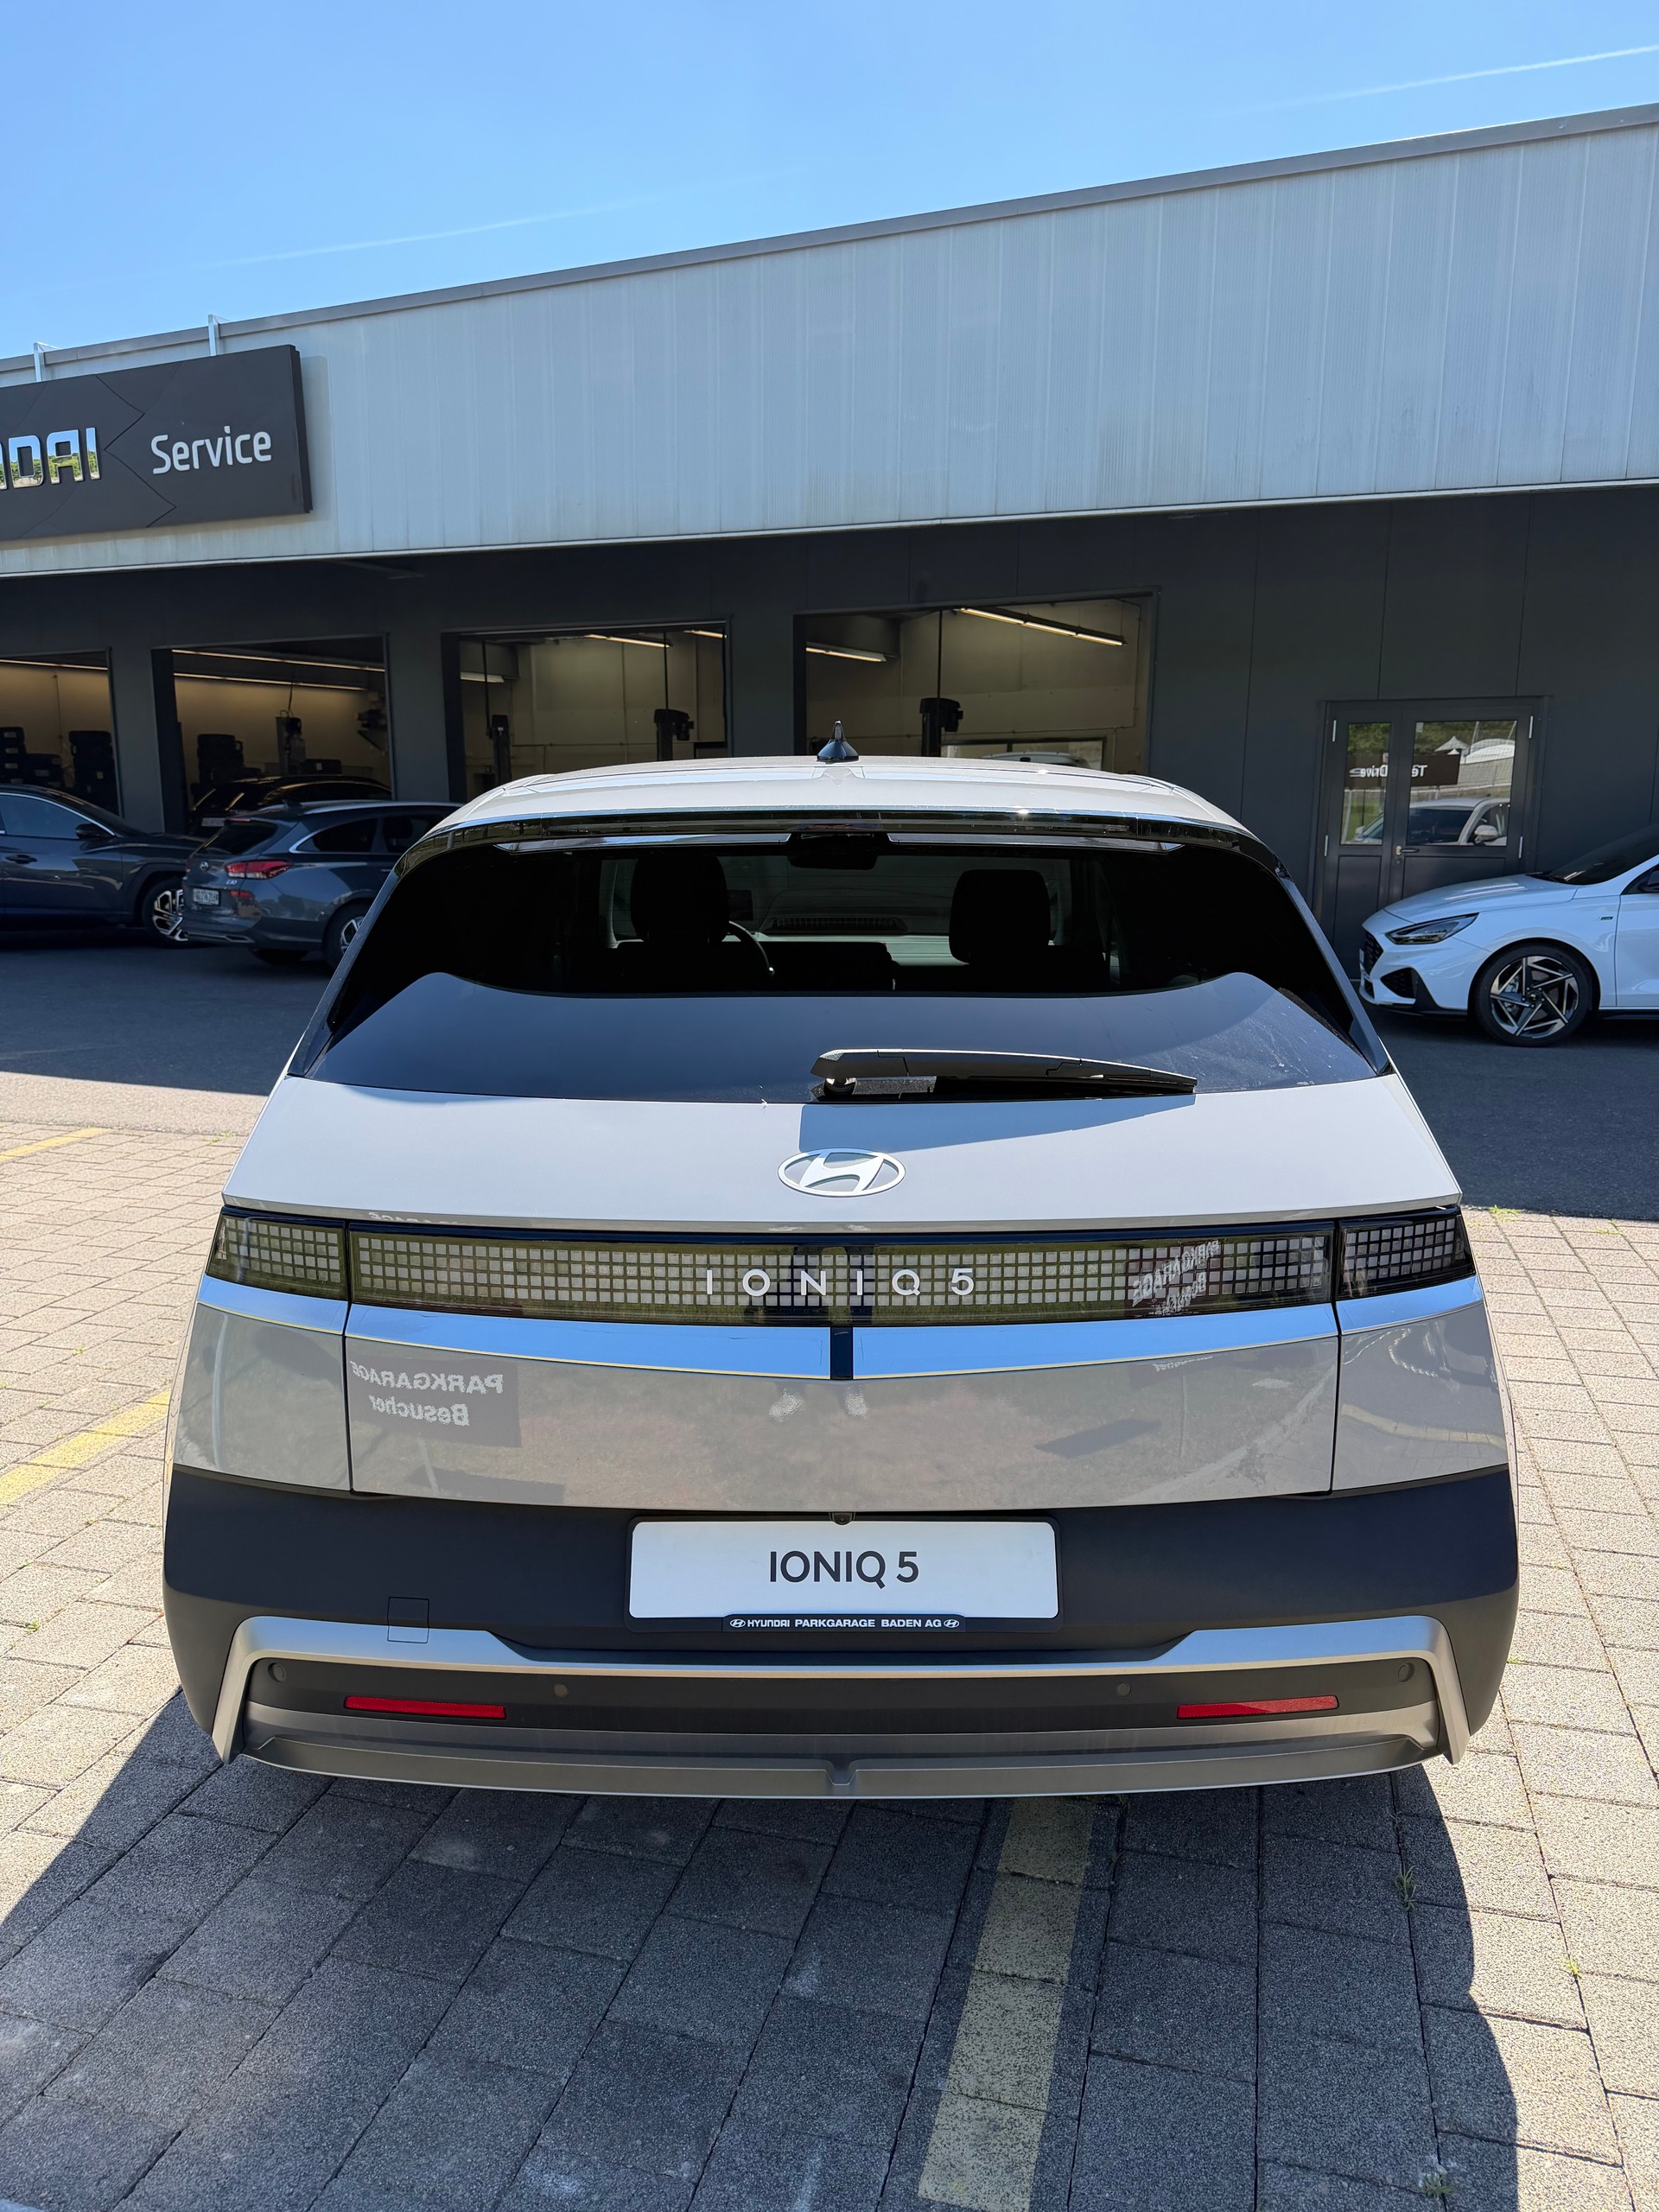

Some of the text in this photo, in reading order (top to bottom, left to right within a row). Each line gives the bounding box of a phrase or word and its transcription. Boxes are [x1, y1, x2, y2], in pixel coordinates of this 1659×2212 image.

[0, 425, 272, 490] DAI Service
[706, 1268, 975, 1296] IONIQ 5
[769, 1550, 919, 1589] IONIQ 5
